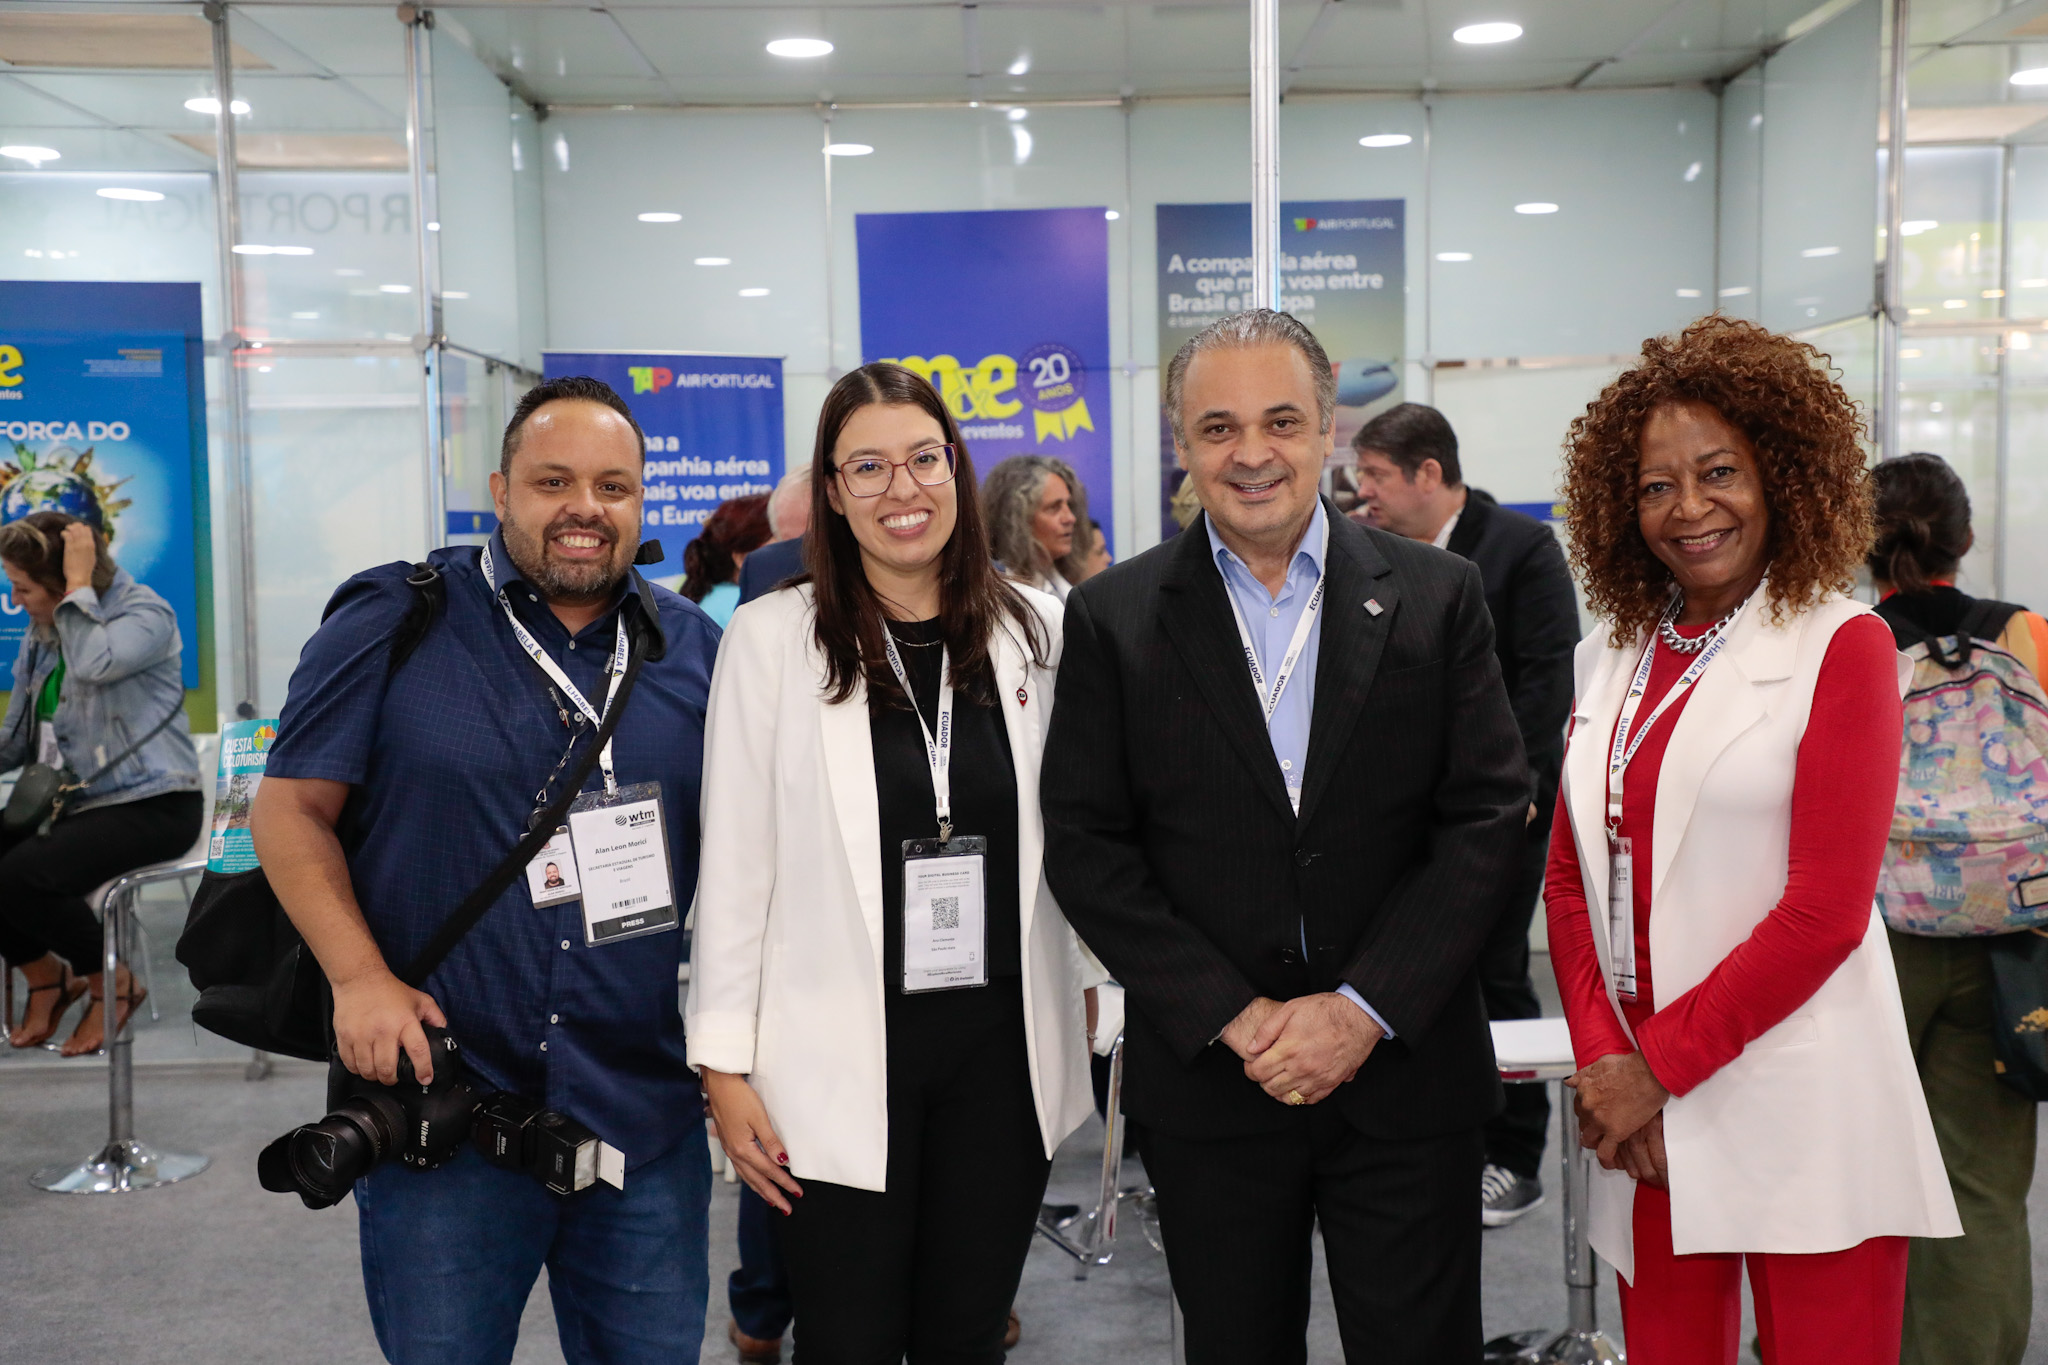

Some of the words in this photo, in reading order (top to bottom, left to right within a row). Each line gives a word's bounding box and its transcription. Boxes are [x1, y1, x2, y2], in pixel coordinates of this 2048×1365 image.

[1168, 253, 1185, 273] A
[1186, 251, 1298, 275] compaia
[1299, 251, 1358, 271] aérea
[1195, 276, 1235, 295] que
[1288, 273, 1326, 291] voa
[1327, 271, 1384, 291] entre
[1168, 293, 1225, 313] Brasil
[1226, 297, 1241, 312] e
[1242, 292, 1316, 314] Eopa
[676, 373, 775, 389] AIRPORTUGAL
[1029, 353, 1071, 388] 20
[1037, 382, 1075, 401] ANOS
[88, 421, 130, 440] DO
[666, 436, 680, 452] a
[713, 454, 770, 476] aérea
[679, 485, 717, 500] voa
[646, 509, 660, 526] e
[662, 505, 716, 526] Euro
[1308, 576, 1326, 611] ECUADO
[616, 630, 628, 667] ILHABELA
[1688, 635, 1727, 676] ILHABELA
[1244, 646, 1263, 684] ECUADOR
[1634, 646, 1655, 687] ILHABELA
[564, 684, 598, 722] ILHABELA
[1267, 674, 1287, 715] ECUADOR
[941, 711, 950, 749] ECUADOR
[1613, 717, 1630, 761] ILHABELA
[1626, 714, 1657, 756] ILHABELA
[222, 752, 268, 769] CICLOTURISM
[628, 810, 655, 822] wtm
[595, 847, 610, 855] Alan
[611, 844, 627, 852] Leon
[621, 917, 645, 929] PRESS
[420, 1119, 430, 1147] Nikon
